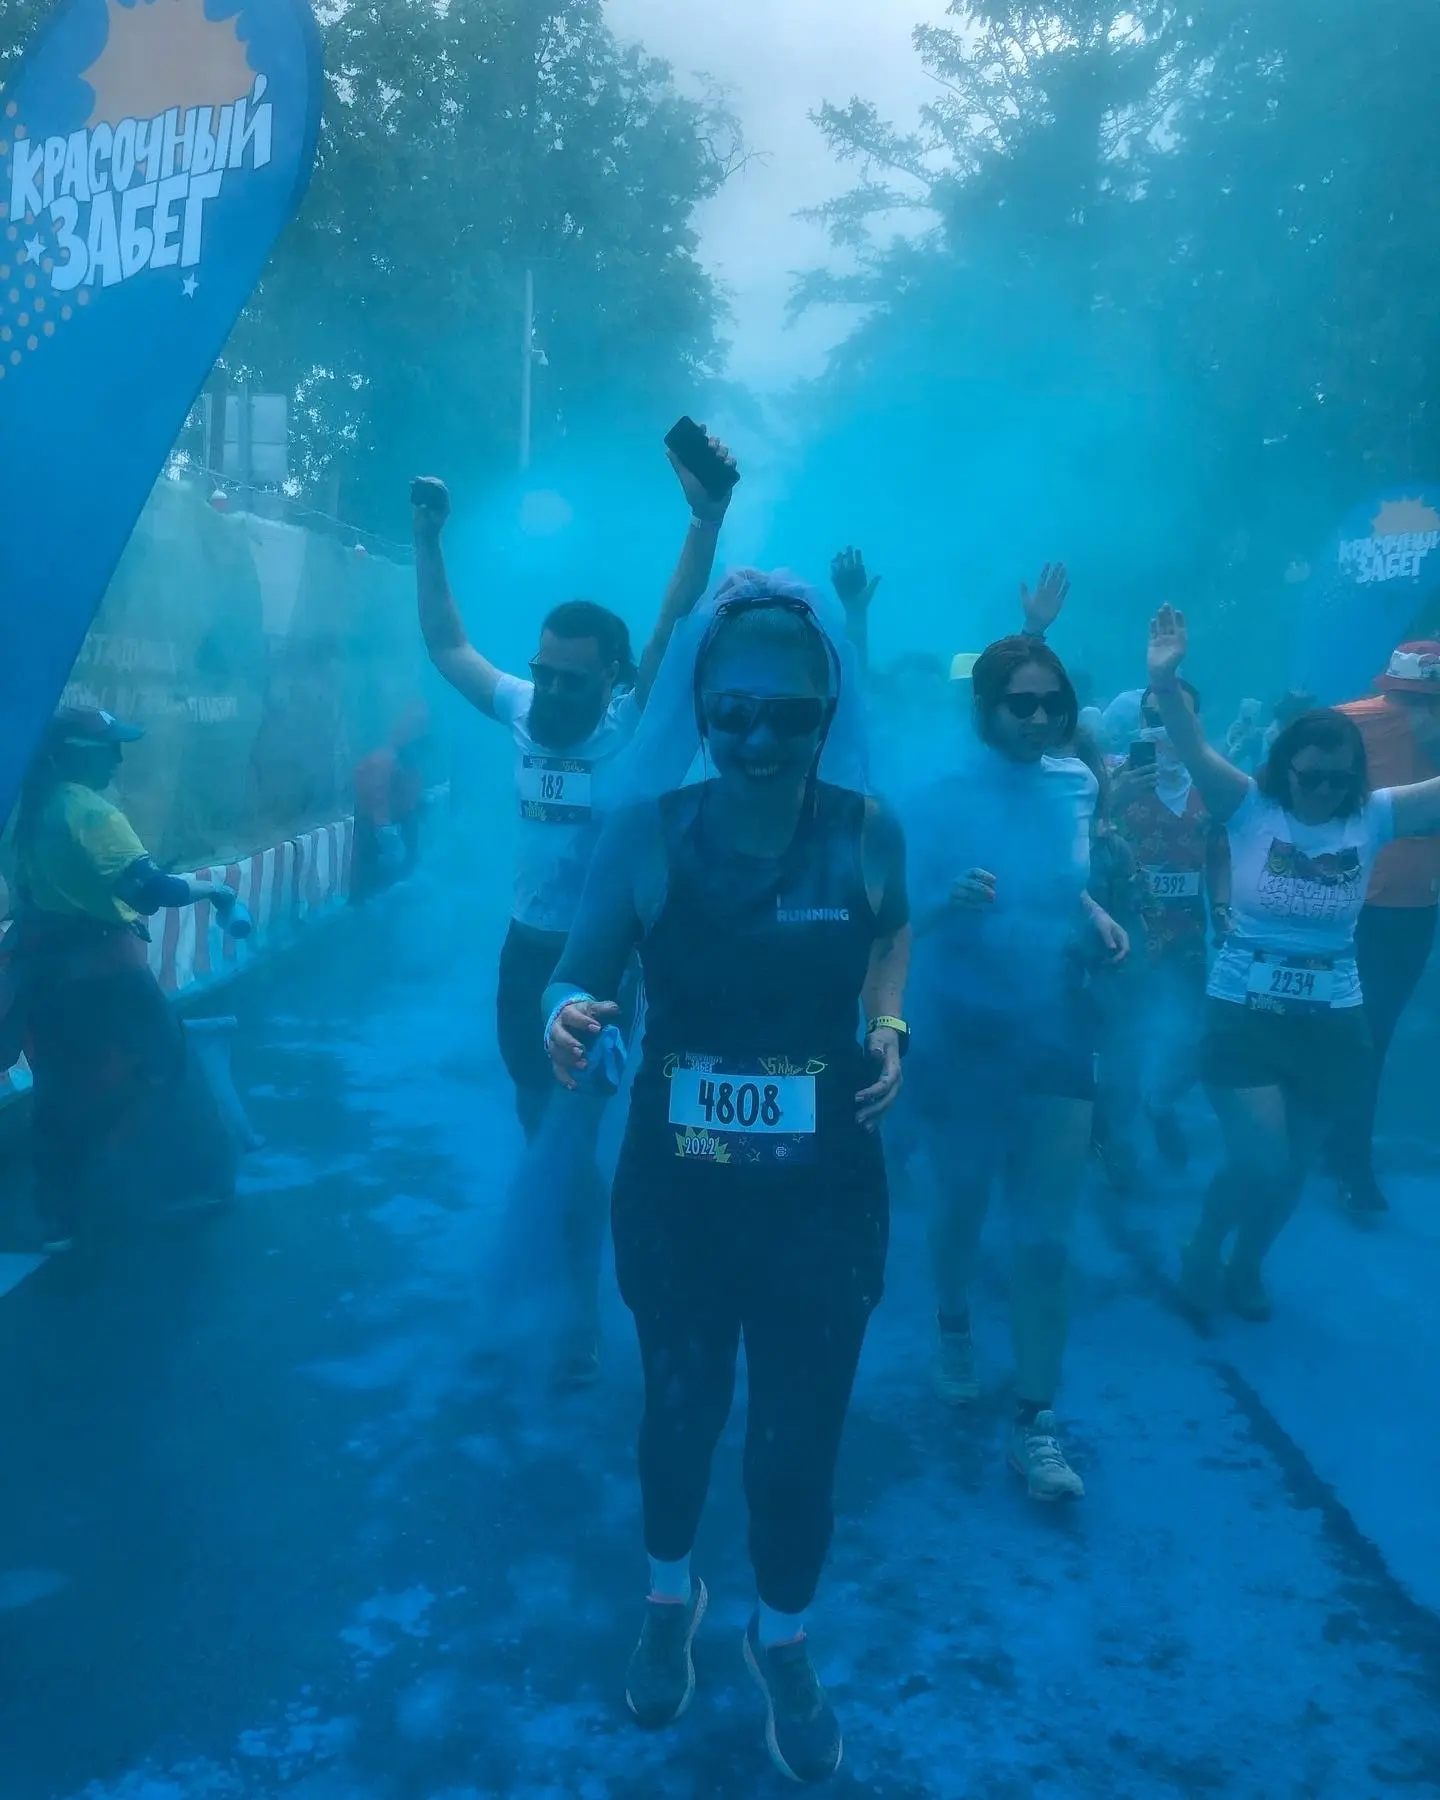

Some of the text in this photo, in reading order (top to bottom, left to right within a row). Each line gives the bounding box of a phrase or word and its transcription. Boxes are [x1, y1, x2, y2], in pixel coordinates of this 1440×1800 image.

[10, 73, 273, 222] КРАСОЧНЫЙ
[50, 169, 223, 291] ЗАБЕГ
[1355, 548, 1428, 584] ЗАБЕГ
[541, 774, 564, 800] 182
[1153, 875, 1186, 894] 2392
[776, 907, 850, 922] RUNNING
[1269, 969, 1315, 996] 2234
[697, 1078, 779, 1127] 4808
[684, 1137, 714, 1156] 2022
